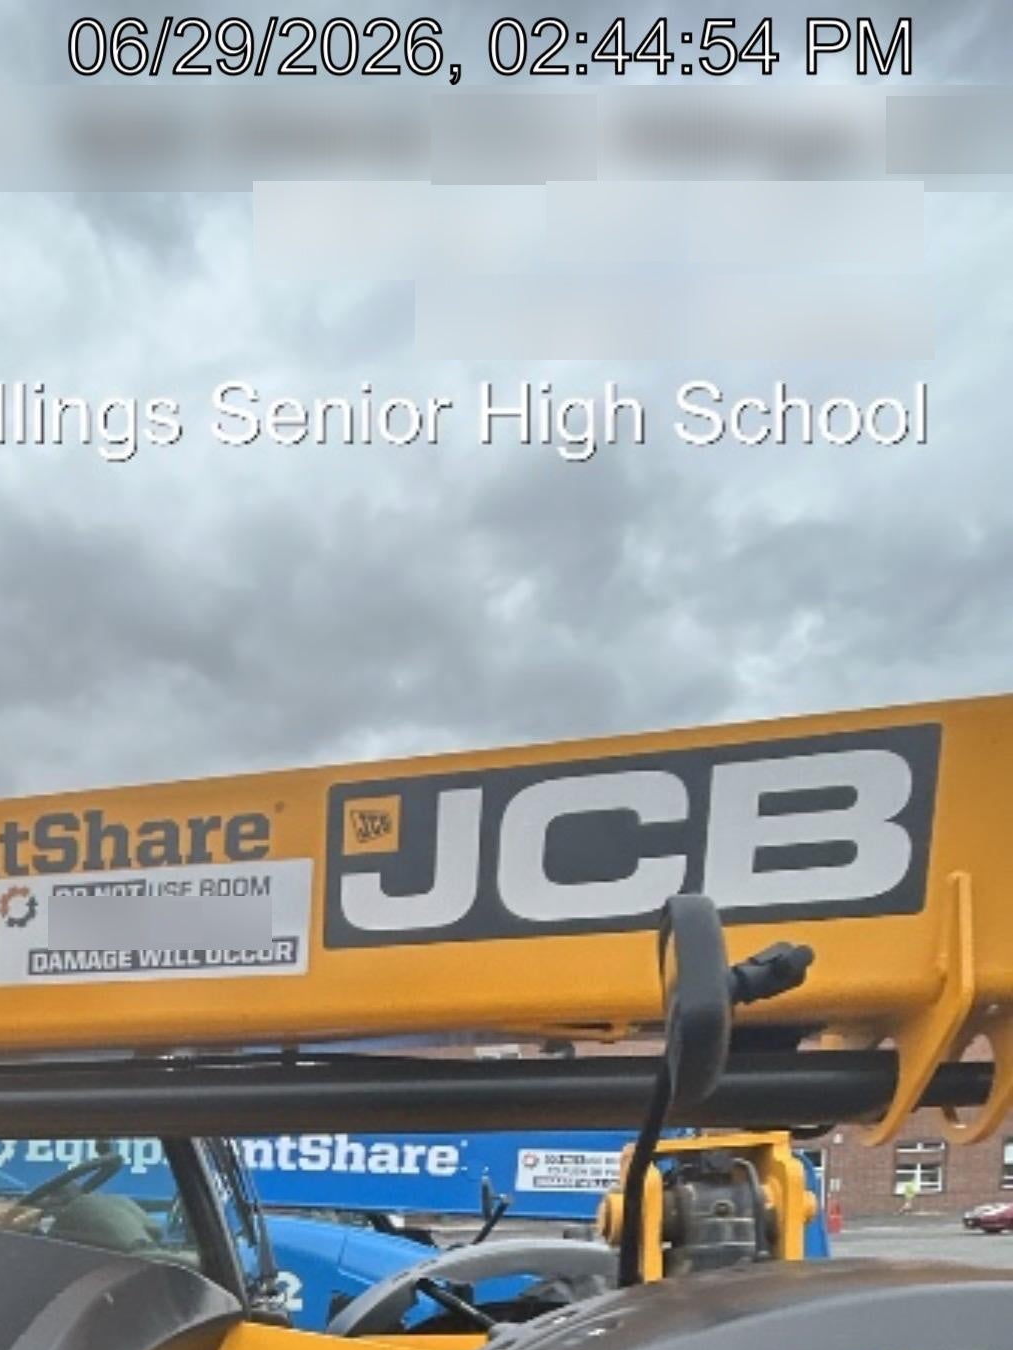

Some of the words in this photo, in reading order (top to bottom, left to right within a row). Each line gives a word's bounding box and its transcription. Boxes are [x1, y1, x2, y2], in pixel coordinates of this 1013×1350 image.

[340, 749, 913, 932] JCB
[32, 949, 132, 972] DAMAGE
[138, 949, 199, 967] WILL
